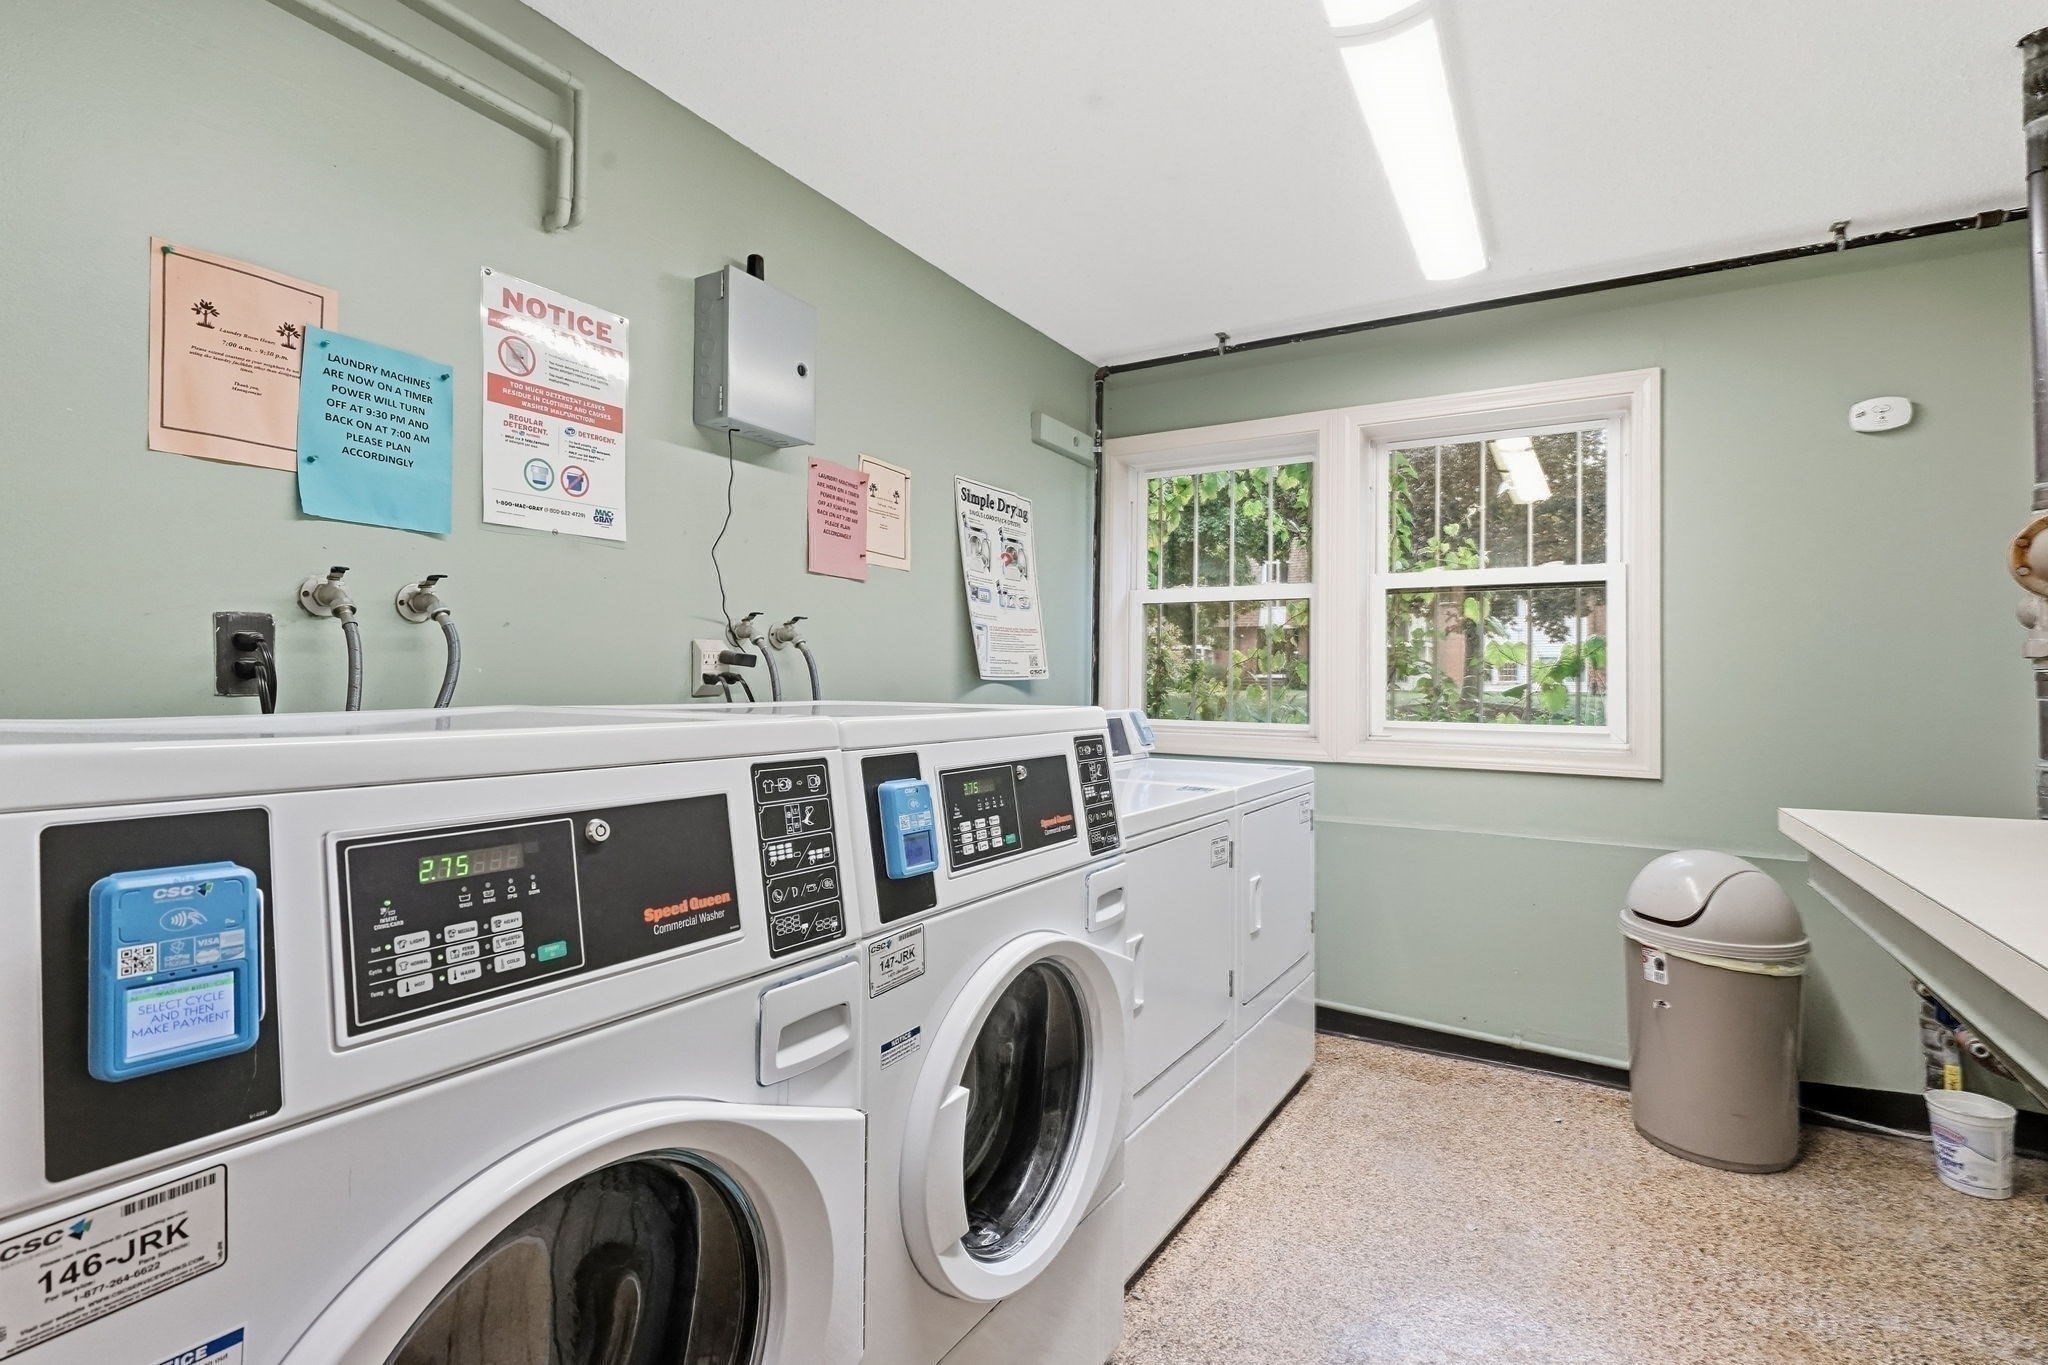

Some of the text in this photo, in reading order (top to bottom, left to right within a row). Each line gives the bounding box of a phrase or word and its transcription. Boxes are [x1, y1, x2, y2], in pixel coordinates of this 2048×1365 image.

[502, 287, 612, 344] NOTICE
[222, 340, 236, 348] 7:00
[239, 345, 252, 353] a.m.
[328, 353, 431, 390] LAUNDRY MACHINES
[323, 368, 433, 404] ARE NOW ON A TIMER
[510, 382, 523, 390] TOO
[525, 385, 544, 396] MUCH
[584, 400, 606, 411] LEAVES
[331, 384, 425, 416] POWER WILL TURN
[502, 388, 532, 400] RESIDUE
[589, 410, 611, 420] CAUSES
[521, 401, 548, 412] WASHER
[326, 398, 429, 430] OFF AT 9:30 PM AND
[509, 413, 543, 427] REGULAR
[325, 413, 430, 444] BACK ON AT 7:00 AM
[503, 420, 548, 436] DETERGENT.
[578, 431, 616, 445] DETERGENT.
[346, 432, 411, 453] PLEASE PLAN
[342, 446, 414, 468] ACCORDINGLY
[820, 491, 835, 500] POWER
[961, 487, 994, 511] Simple
[997, 498, 1028, 523] Dryng
[593, 515, 613, 524] GRAY
[419, 855, 469, 882] 2.75
[153, 885, 194, 899] CSC
[644, 892, 731, 922] Speed Queen
[654, 910, 725, 935] Commercial Washer
[198, 938, 219, 946] VISA
[871, 943, 886, 953] CSC
[880, 947, 915, 971] 147-JRK
[138, 991, 224, 1015] SELECT CYCLE
[151, 1003, 214, 1024] AND THEN
[131, 1010, 230, 1038] MAKE PAYMENT
[0, 1230, 64, 1262] CSC
[38, 1217, 189, 1293] 146-JRK
[139, 1256, 155, 1265] Para
[44, 1280, 95, 1303] For Service:
[74, 1261, 160, 1302] 1-877-264-6622
